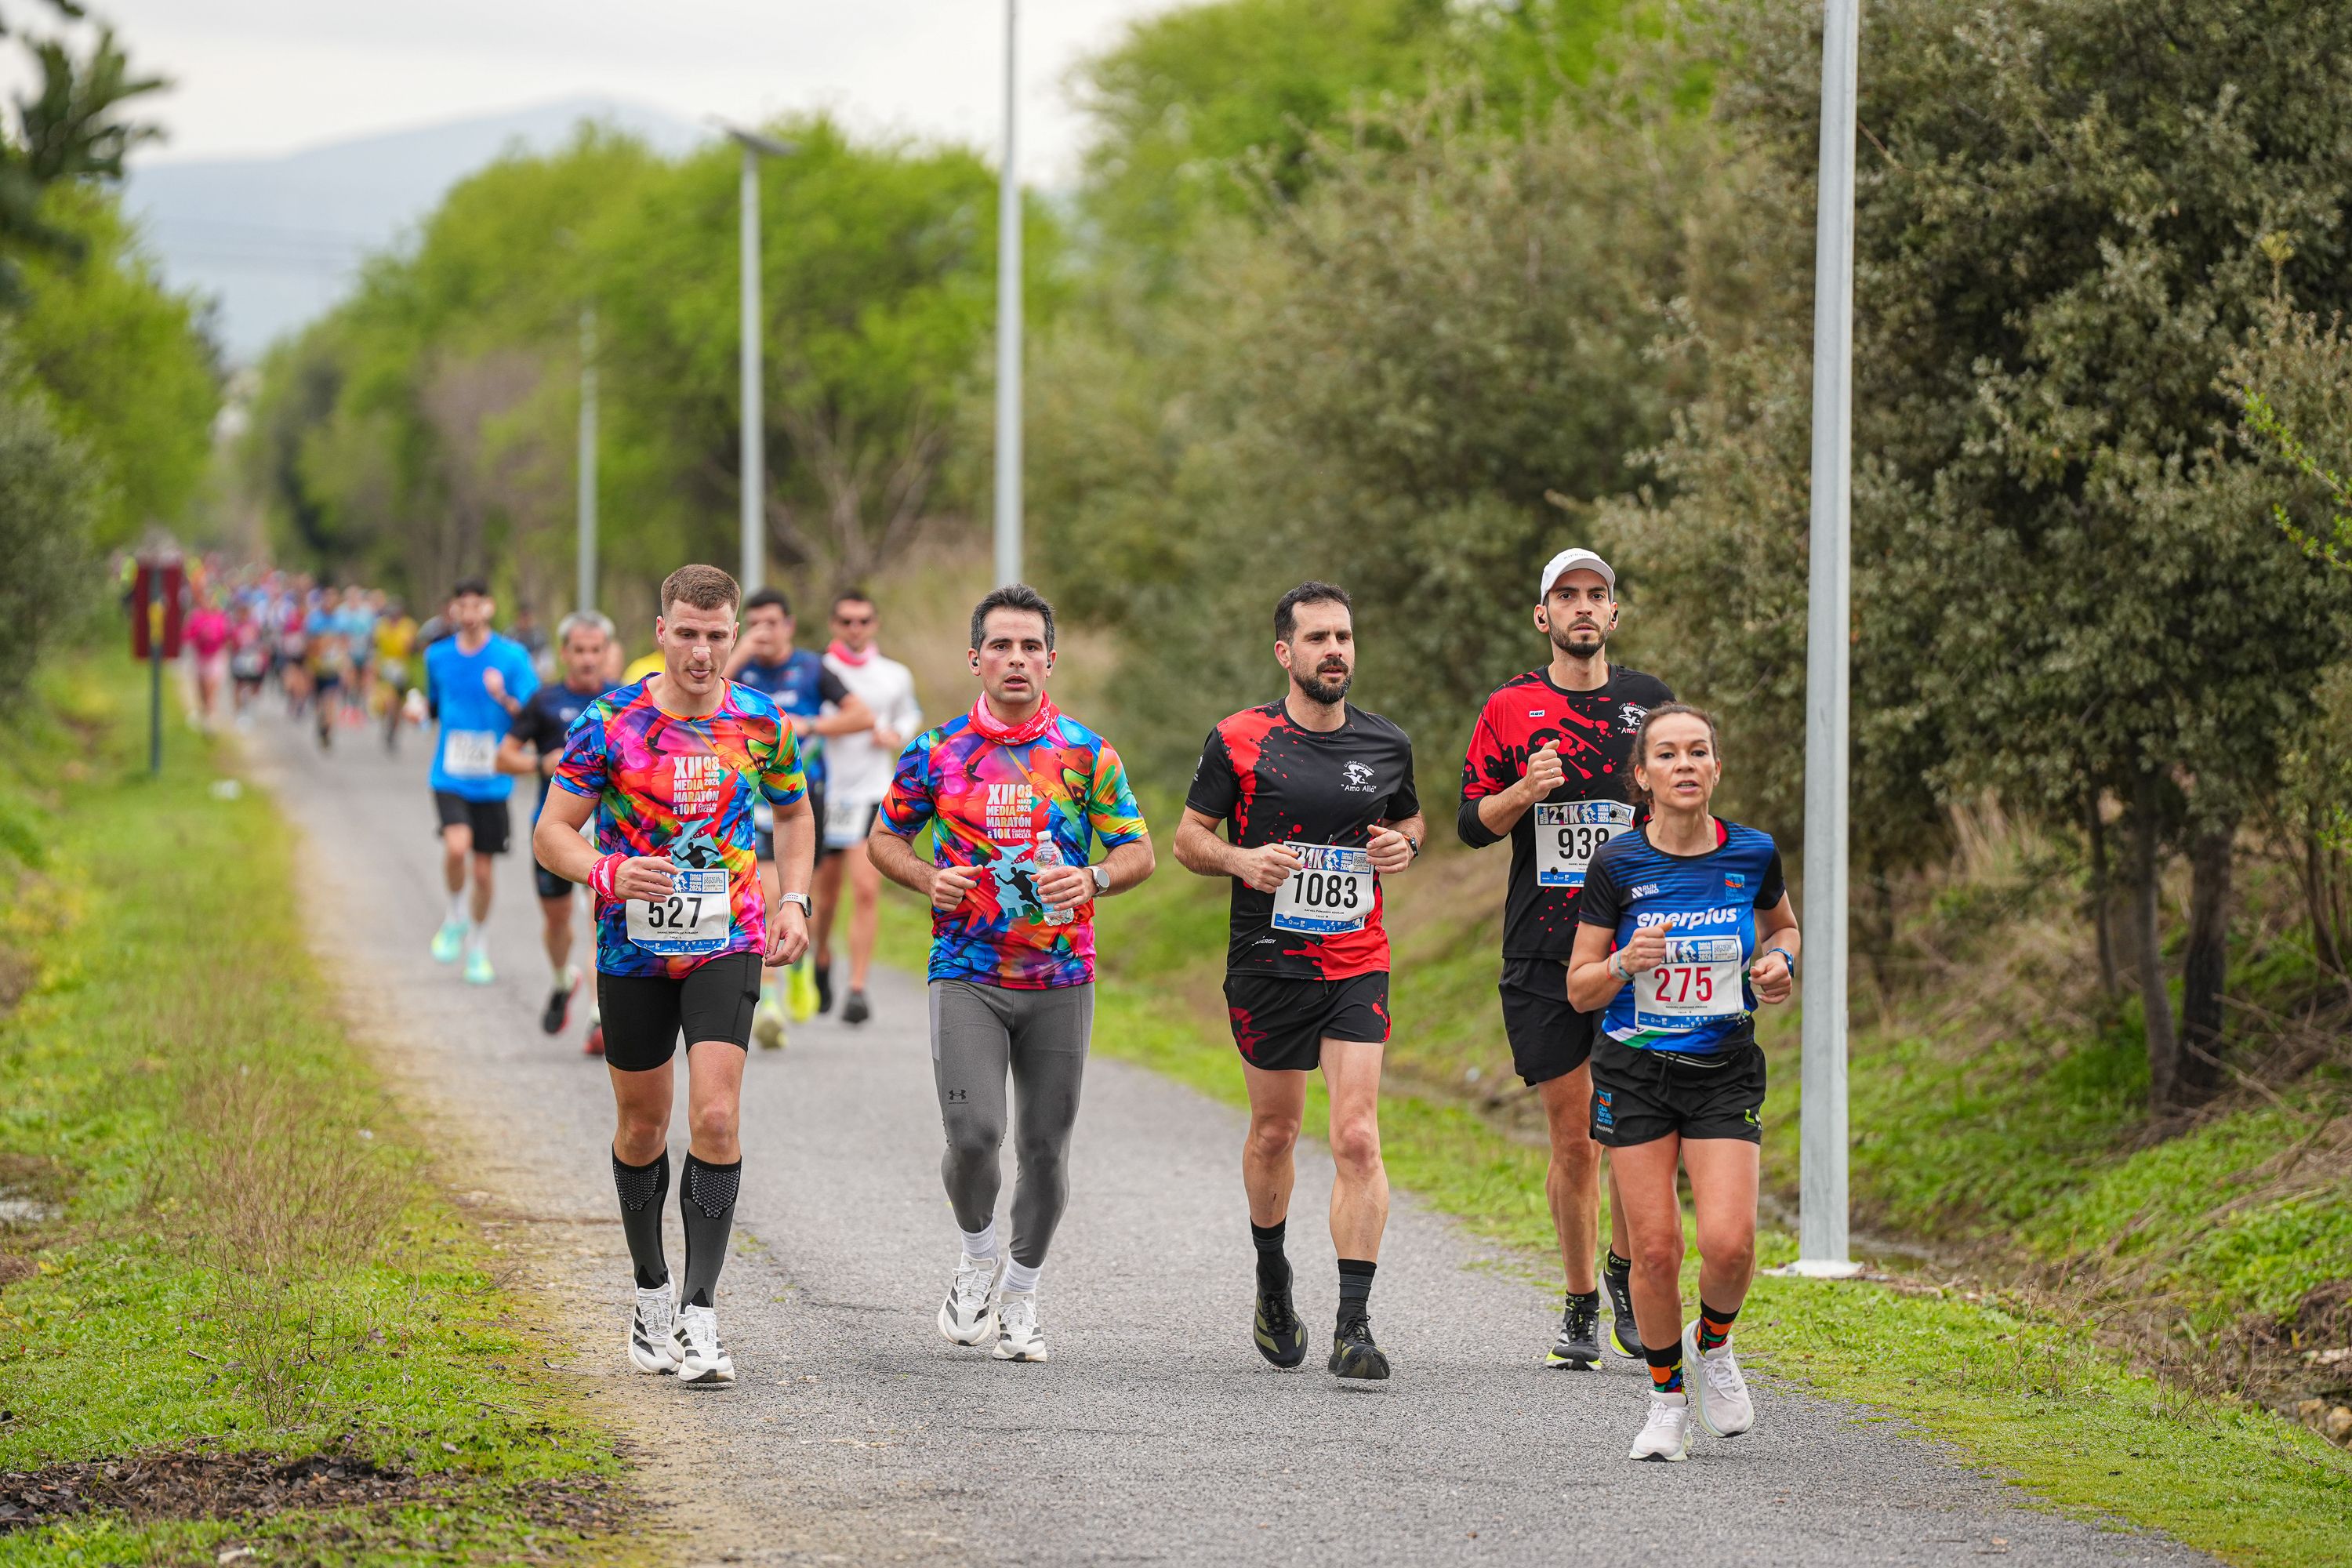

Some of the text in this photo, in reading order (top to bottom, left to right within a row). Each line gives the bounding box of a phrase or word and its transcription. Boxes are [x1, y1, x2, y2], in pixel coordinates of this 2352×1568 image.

[673, 756, 702, 779] XII
[703, 756, 720, 771] 08
[673, 779, 704, 791] MEDIA
[703, 778, 720, 786] 2026
[673, 788, 720, 803] MARATÓN
[986, 784, 1016, 805] XII
[1016, 784, 1033, 798] 08
[672, 803, 697, 815] & 10K
[985, 805, 1016, 816] MEDIA
[1549, 805, 1581, 824] 21K
[985, 814, 1032, 828] MARATÓN
[987, 828, 1011, 839] & 10K
[1293, 872, 1358, 909] 1083
[1642, 884, 1657, 892] RUN
[648, 897, 702, 928] 527
[1637, 908, 1737, 931] enerplus
[1654, 967, 1712, 1002] 275
